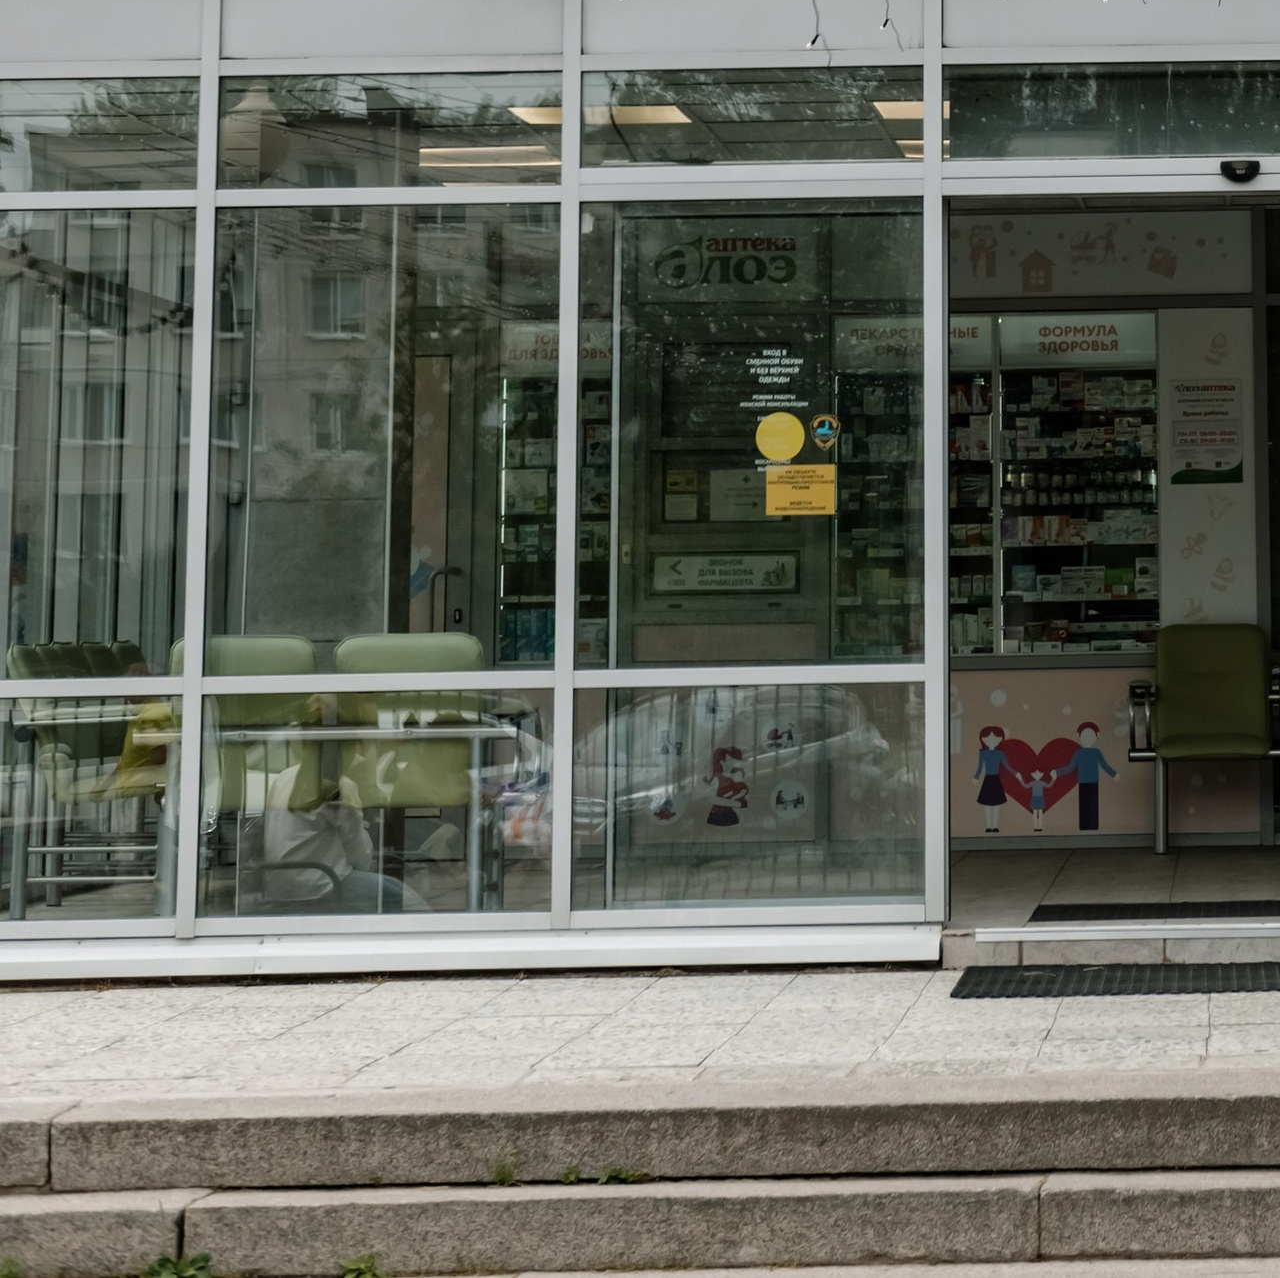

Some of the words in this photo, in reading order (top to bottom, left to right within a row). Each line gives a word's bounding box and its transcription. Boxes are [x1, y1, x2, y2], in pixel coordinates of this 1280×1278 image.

[705, 237, 797, 252] аптека
[1039, 324, 1118, 337] ФОРМУЛА
[1039, 339, 1118, 355] ЗДОРОВЬЯ
[762, 349, 782, 357] ВХОД
[745, 357, 780, 365] СМЕННОЙ
[769, 365, 800, 374] ВЕРХНЕЙ
[708, 558, 744, 566] ЗВОНОК
[698, 569, 716, 577] ДЛЯ
[718, 568, 754, 576] ВЫЗОВА
[697, 578, 754, 586] ФАРМАЦЕВТА
